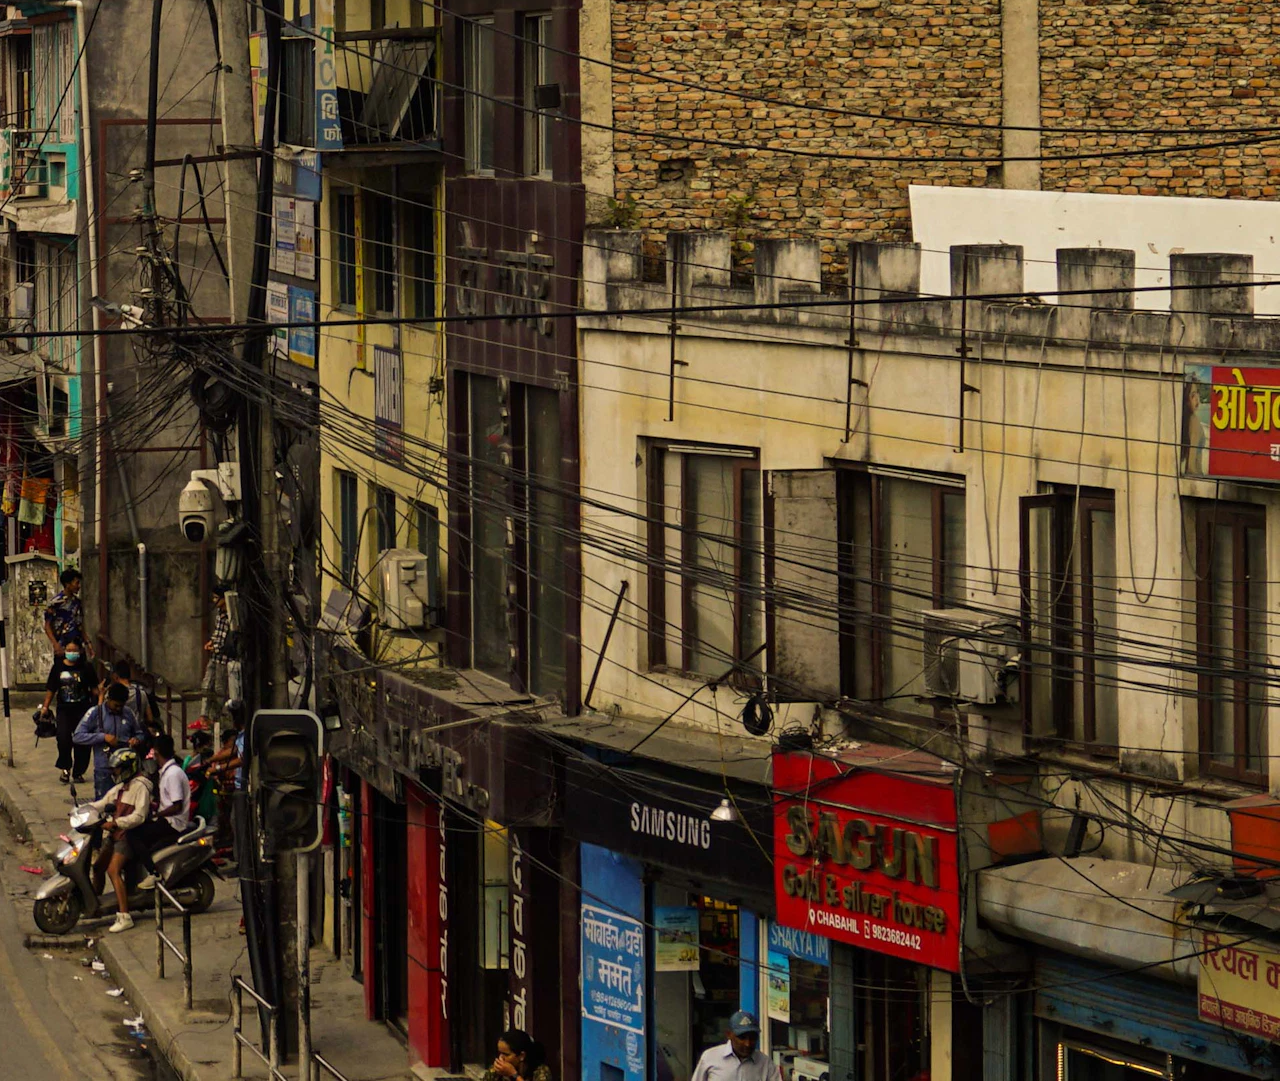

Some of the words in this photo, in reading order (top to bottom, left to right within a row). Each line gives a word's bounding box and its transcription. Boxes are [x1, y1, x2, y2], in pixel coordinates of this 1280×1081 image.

[630, 802, 711, 850] SAMSUNG
[785, 805, 939, 889] SAGUN
[782, 864, 822, 904] Gold
[825, 873, 841, 907] &
[842, 879, 891, 919] silver
[891, 889, 948, 934] house
[816, 909, 860, 934] CHABAHIL
[872, 924, 921, 950] 9823682442
[598, 955, 632, 998] मर्मत
